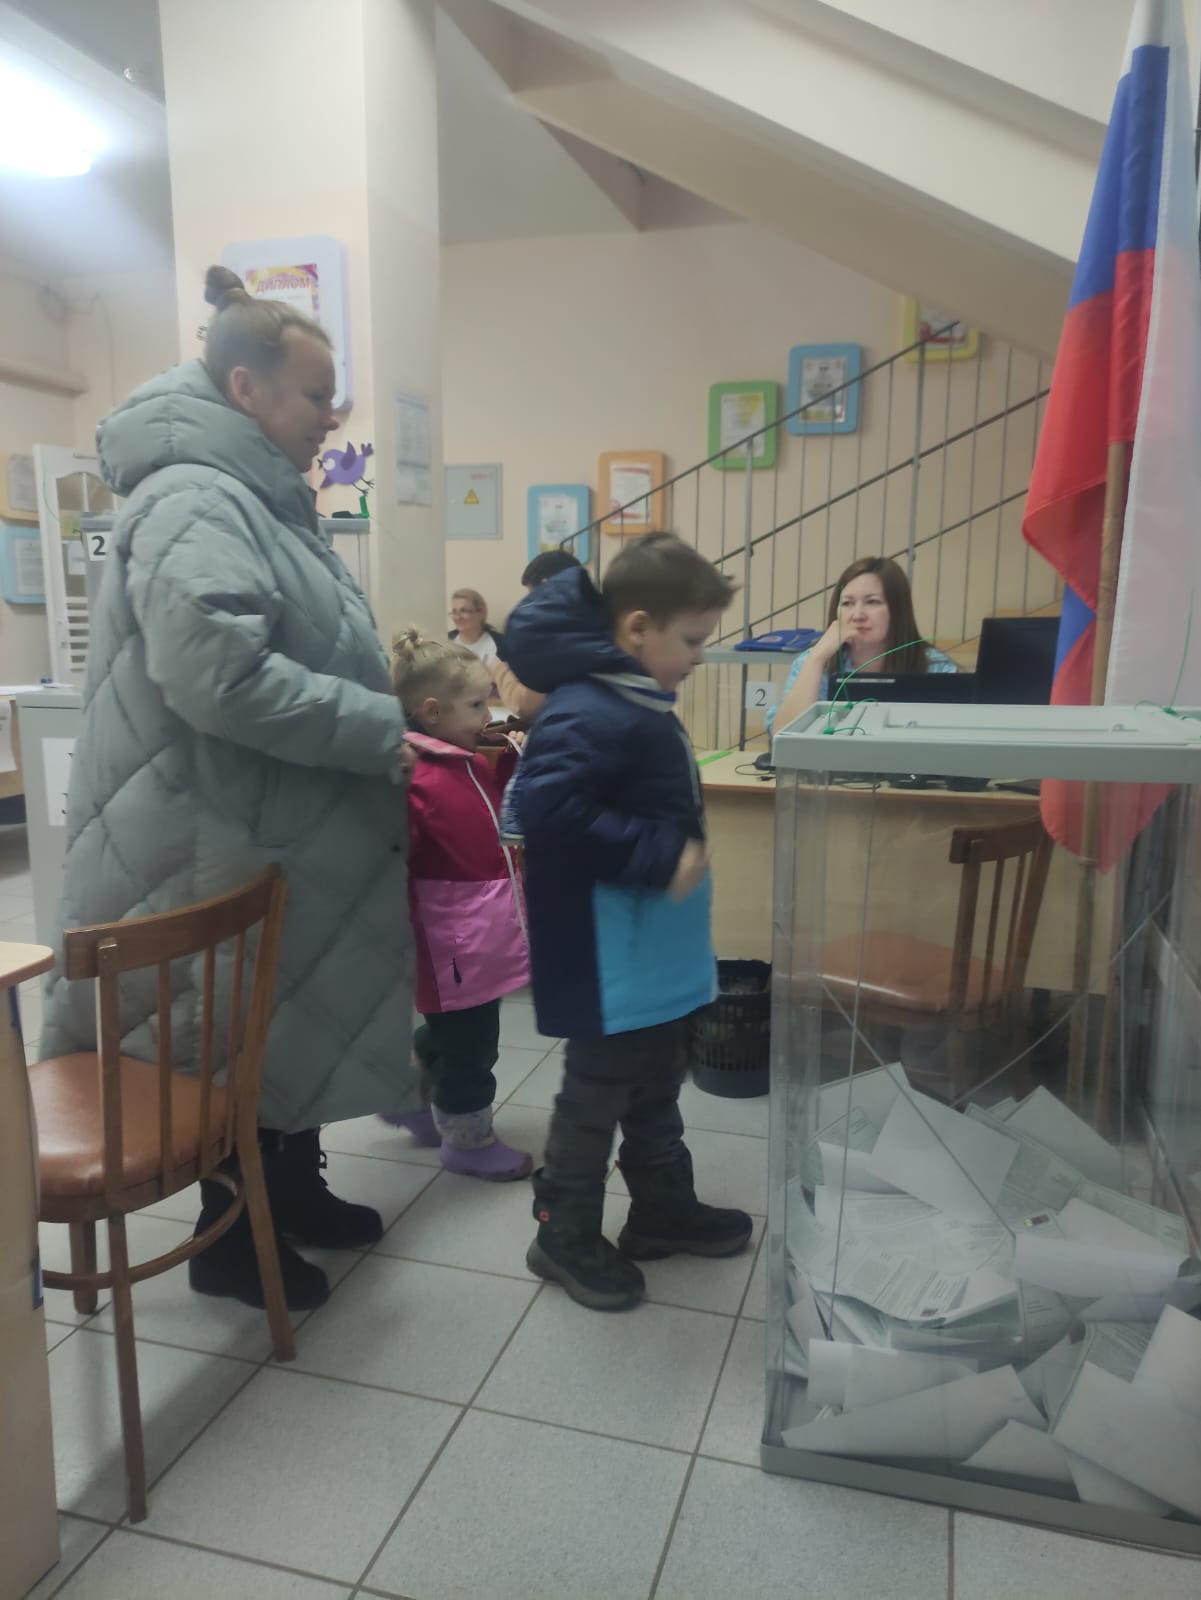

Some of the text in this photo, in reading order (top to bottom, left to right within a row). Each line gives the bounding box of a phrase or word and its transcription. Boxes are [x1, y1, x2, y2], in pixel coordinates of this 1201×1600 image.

[256, 277, 310, 292] ДИПЛОМ
[91, 535, 106, 556] 2
[755, 688, 768, 707] 2
